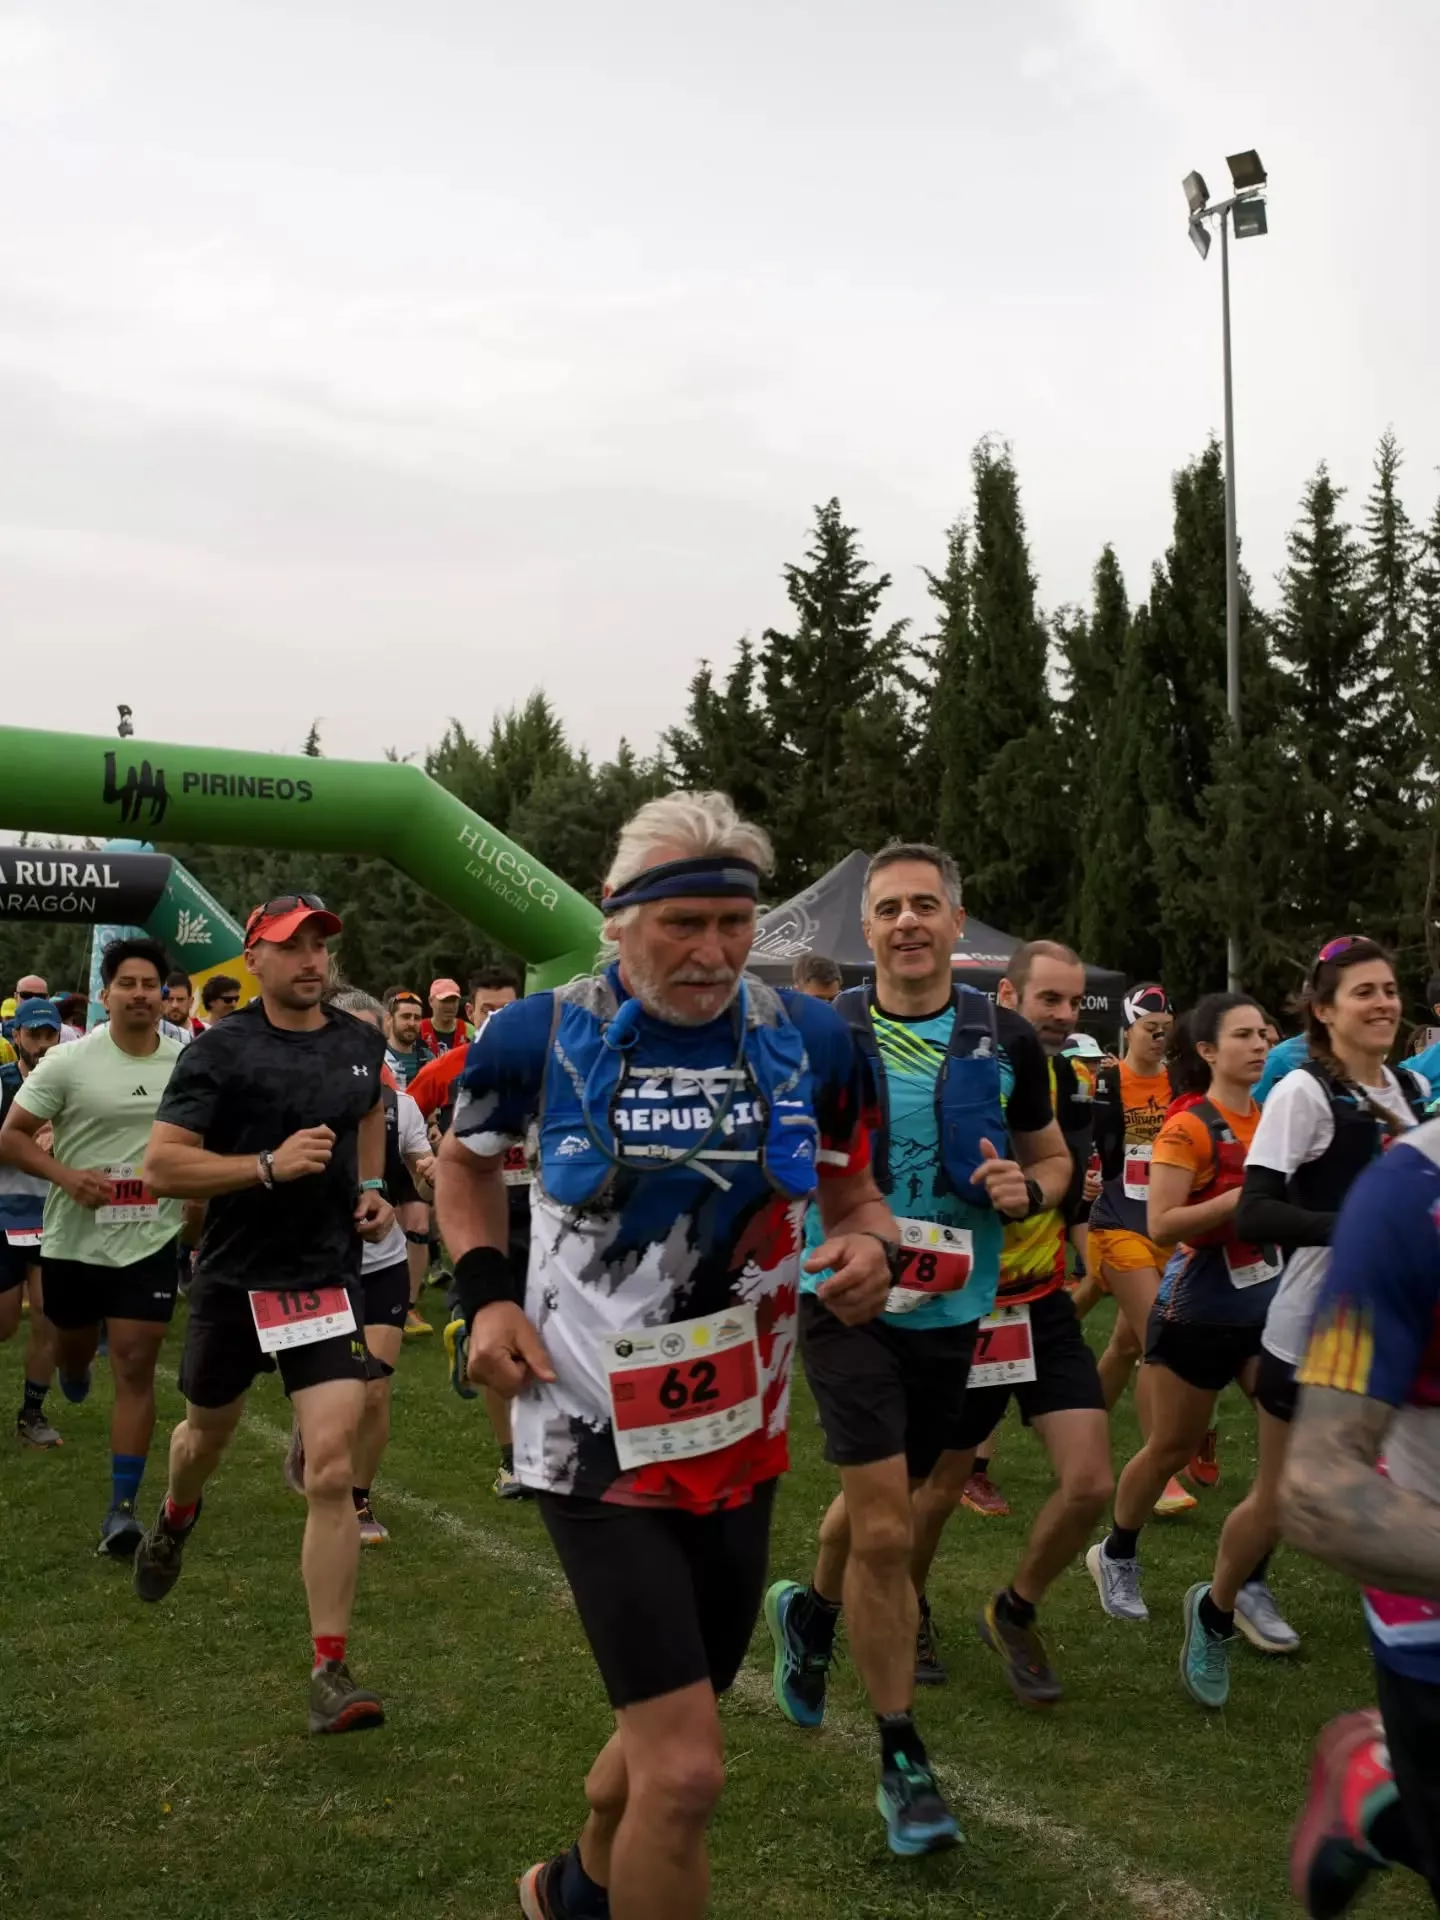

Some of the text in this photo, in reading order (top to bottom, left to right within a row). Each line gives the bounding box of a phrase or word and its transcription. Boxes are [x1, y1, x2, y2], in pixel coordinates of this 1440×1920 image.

[182, 771, 313, 803] PIRINEOS
[15, 860, 120, 888] RURAL
[0, 892, 96, 914] RAGÓN
[614, 1101, 764, 1131] REPUBIC
[114, 1181, 143, 1200] 114
[895, 1251, 938, 1283] 78
[277, 1288, 322, 1316] 113
[658, 1359, 720, 1411] 62
